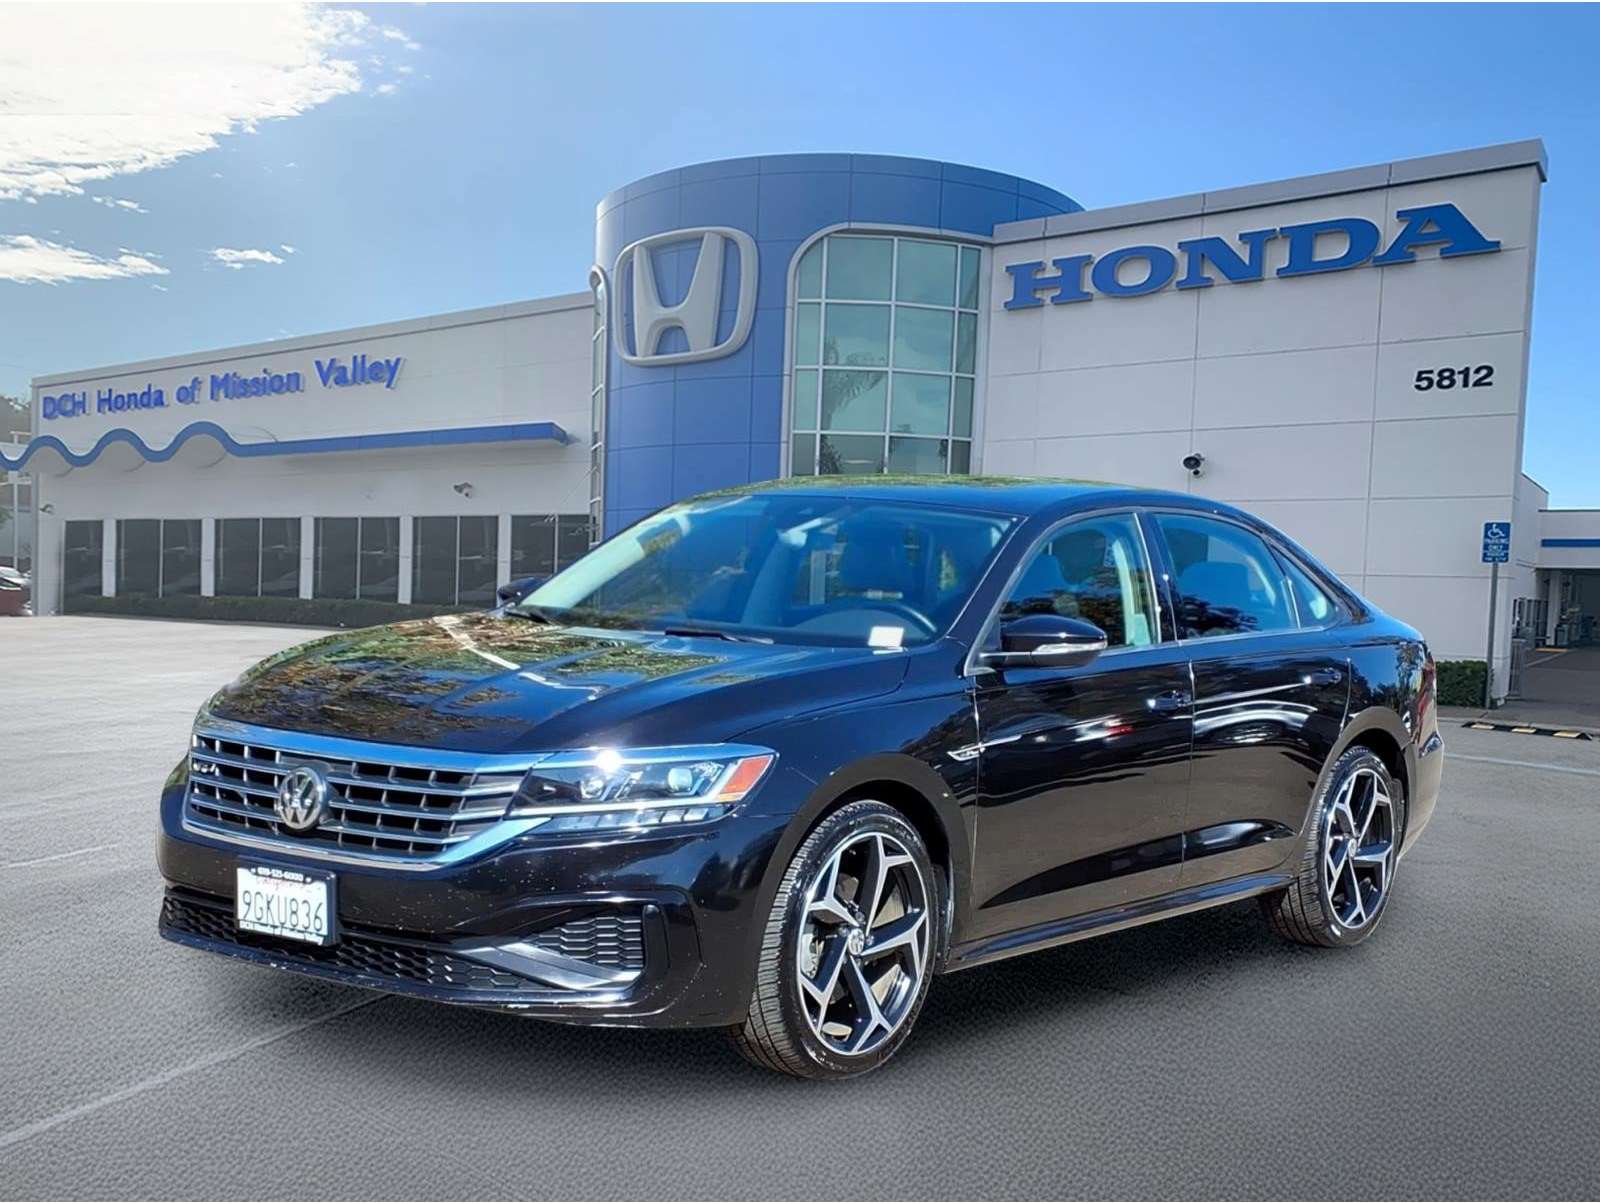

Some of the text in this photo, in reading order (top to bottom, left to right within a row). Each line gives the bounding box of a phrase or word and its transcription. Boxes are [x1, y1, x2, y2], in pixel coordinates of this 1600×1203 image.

[1004, 203, 1501, 310] HONDA
[42, 354, 406, 420] DCH Honda of Mission Valley
[1414, 364, 1495, 392] 5812
[242, 890, 323, 932] 9GKU836
